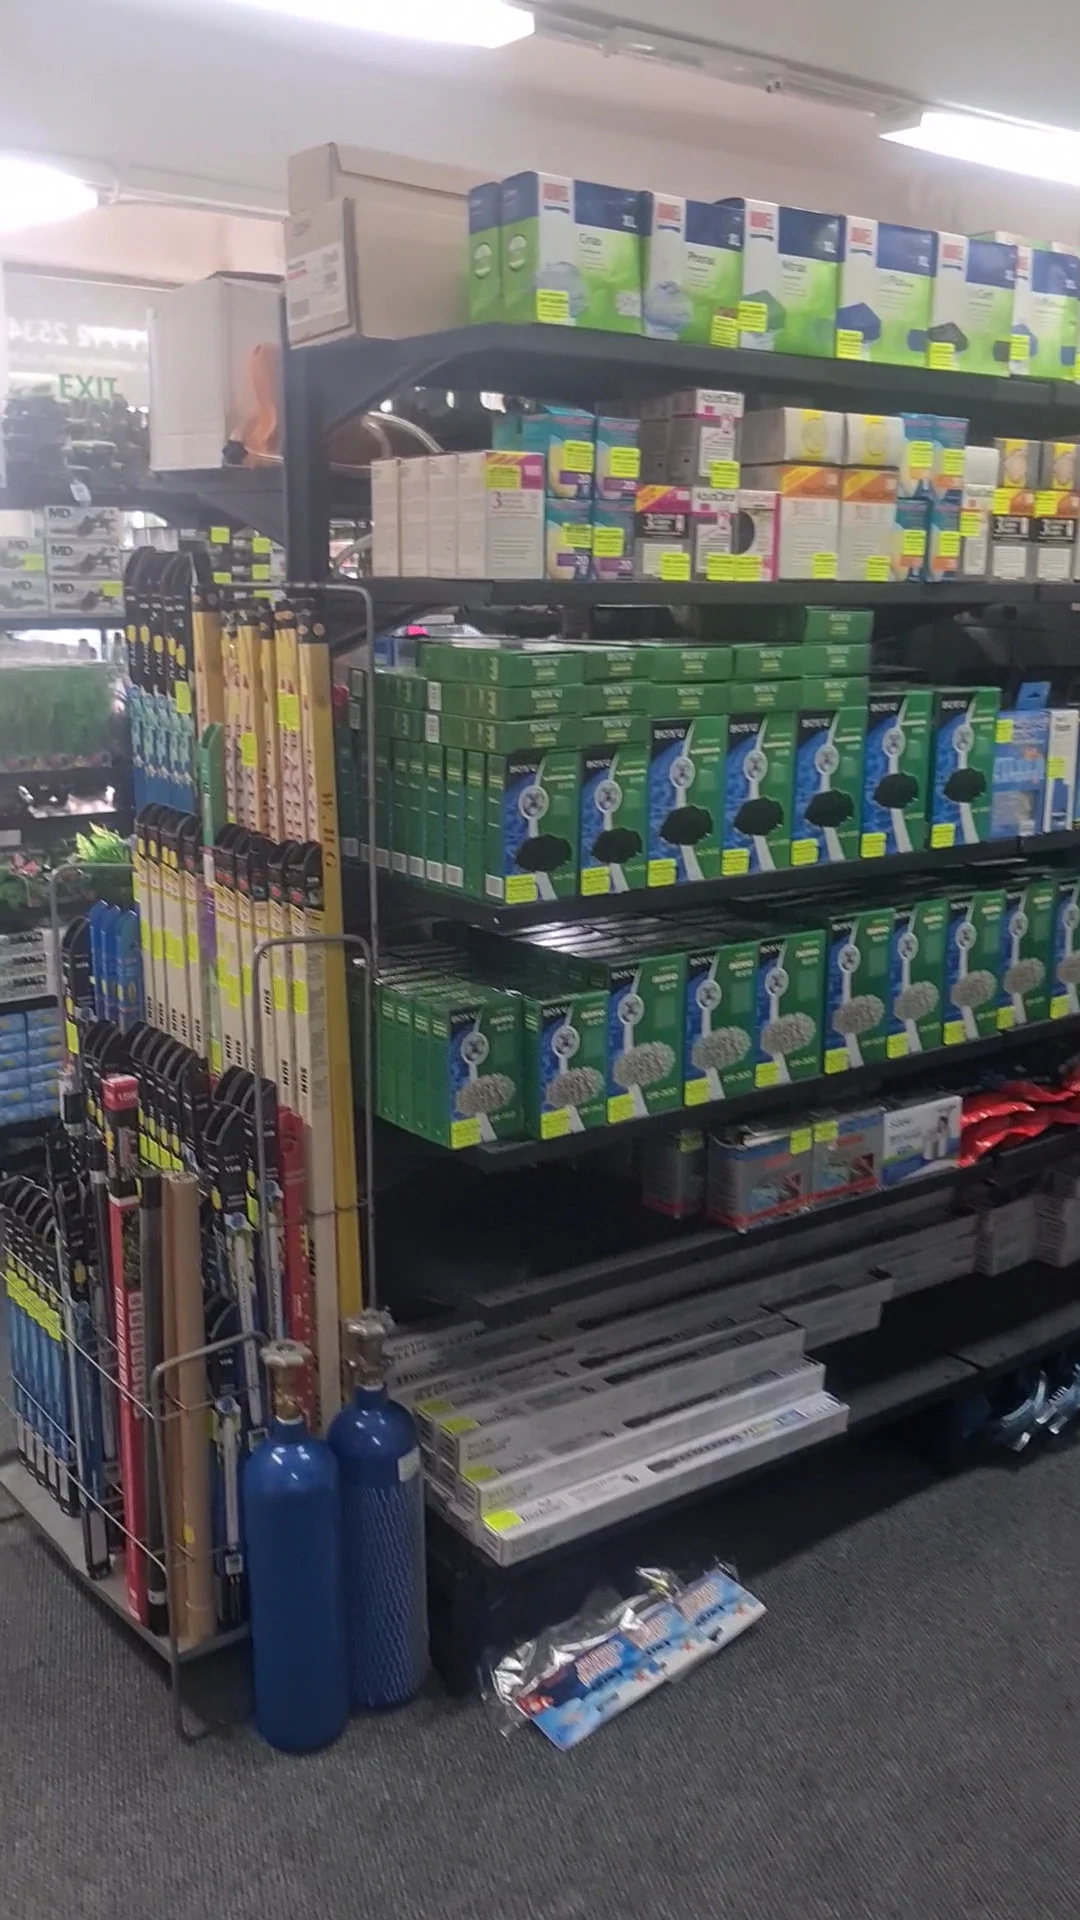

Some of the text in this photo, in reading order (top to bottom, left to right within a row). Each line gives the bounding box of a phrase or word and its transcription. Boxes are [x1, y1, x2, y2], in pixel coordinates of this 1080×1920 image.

[59, 374, 118, 400] EXIT
[491, 491, 503, 509] 3
[48, 508, 71, 520] MD
[50, 545, 73, 557] MD
[10, 581, 32, 591] MD
[52, 583, 75, 595] MD
[263, 988, 272, 1016] SUN
[281, 1059, 289, 1086] SUN
[300, 1066, 308, 1094] SUN
